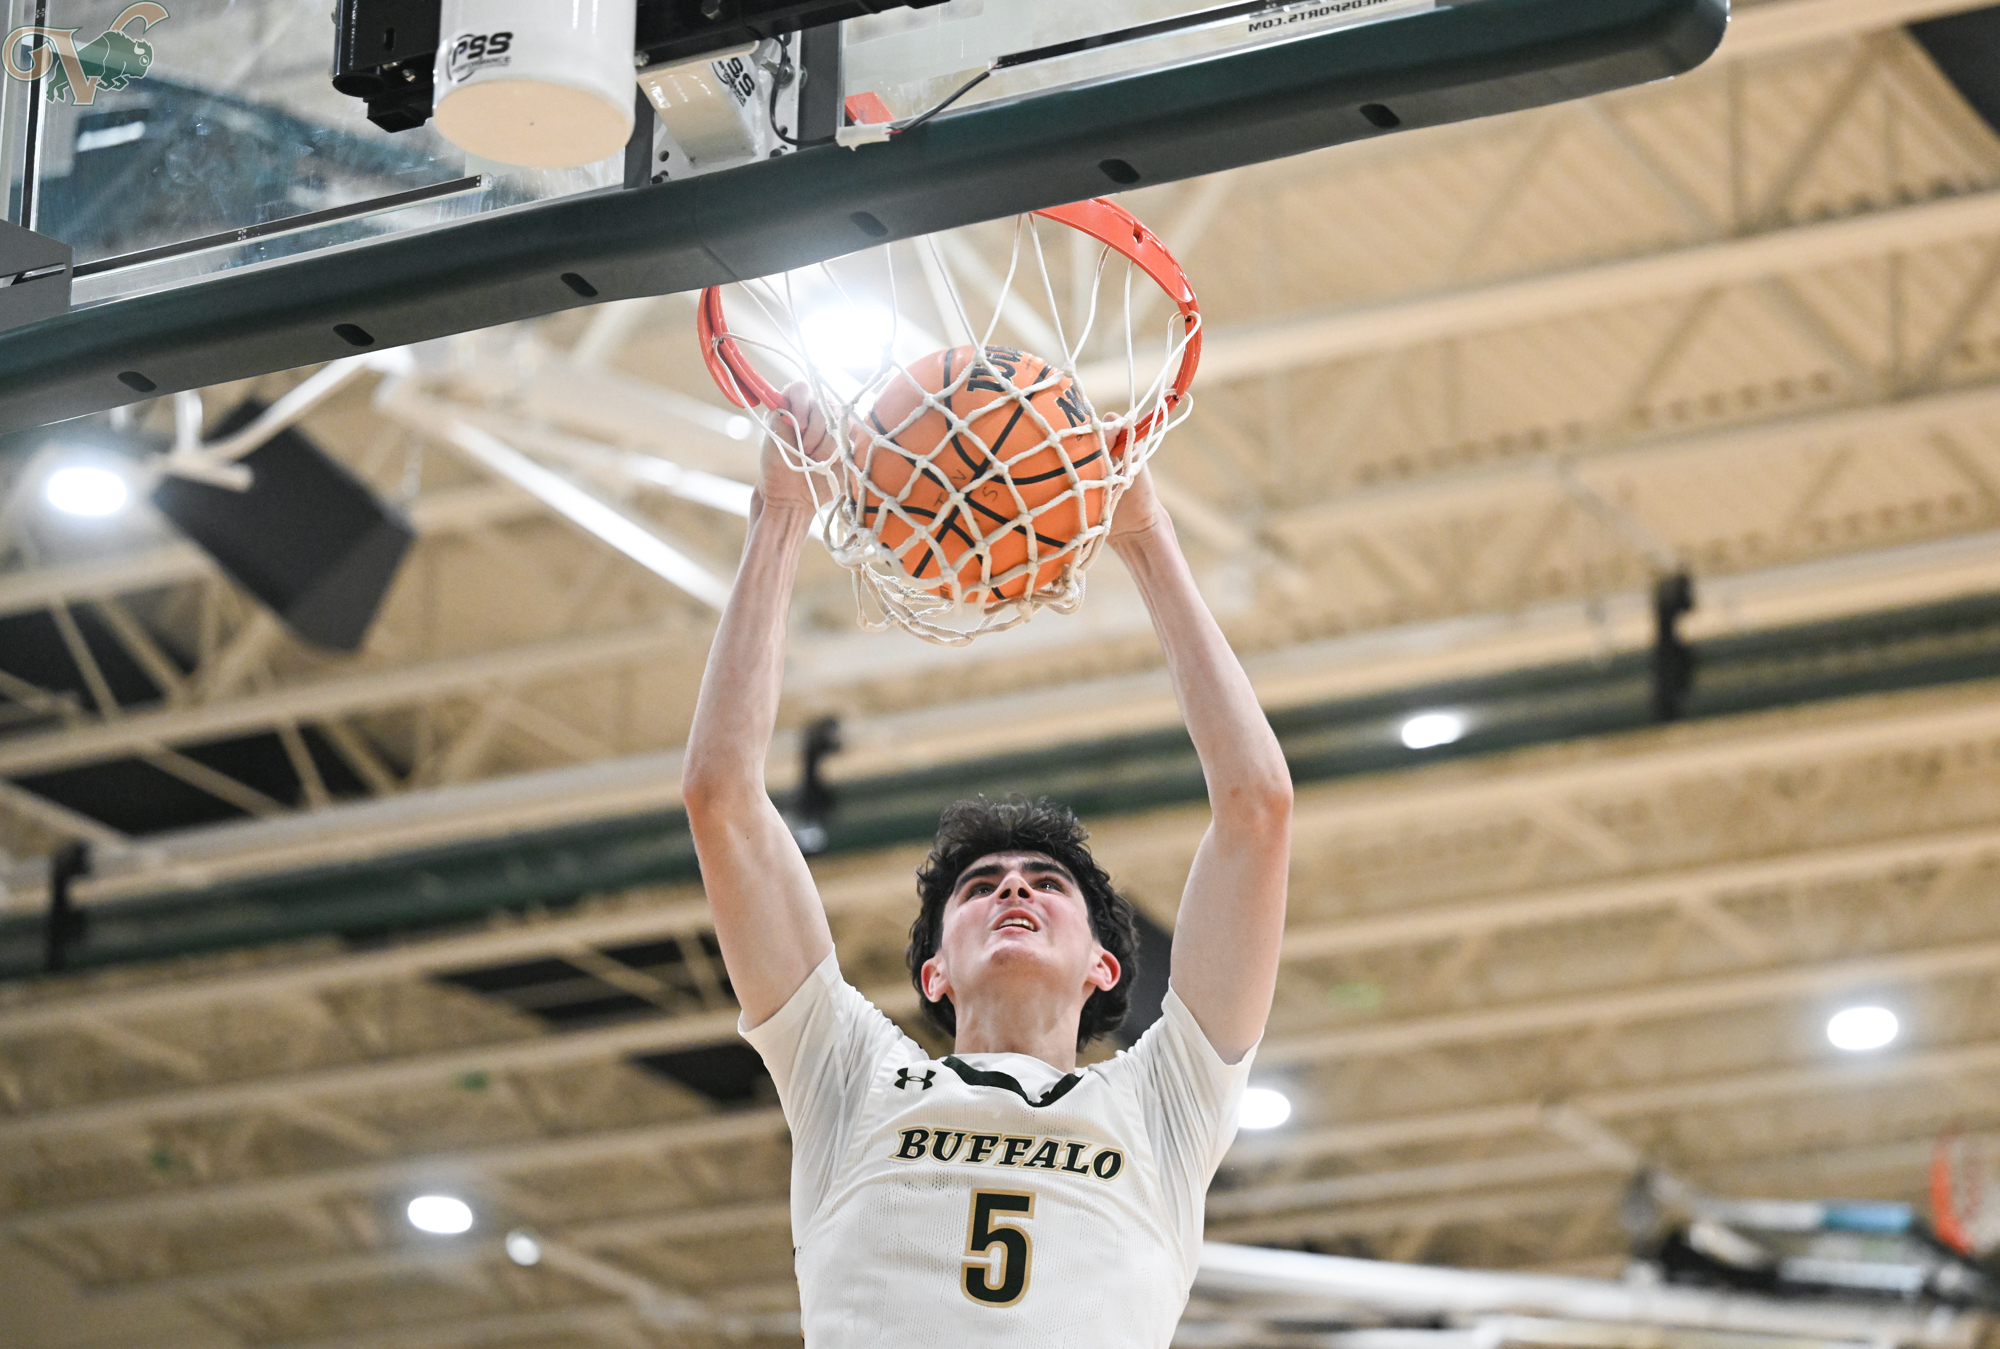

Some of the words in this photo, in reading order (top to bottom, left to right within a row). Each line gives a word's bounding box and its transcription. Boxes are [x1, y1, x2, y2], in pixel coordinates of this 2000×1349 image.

[452, 32, 513, 66] PSS
[891, 1127, 1124, 1181] BUFFALO
[961, 1188, 1036, 1308] 5
